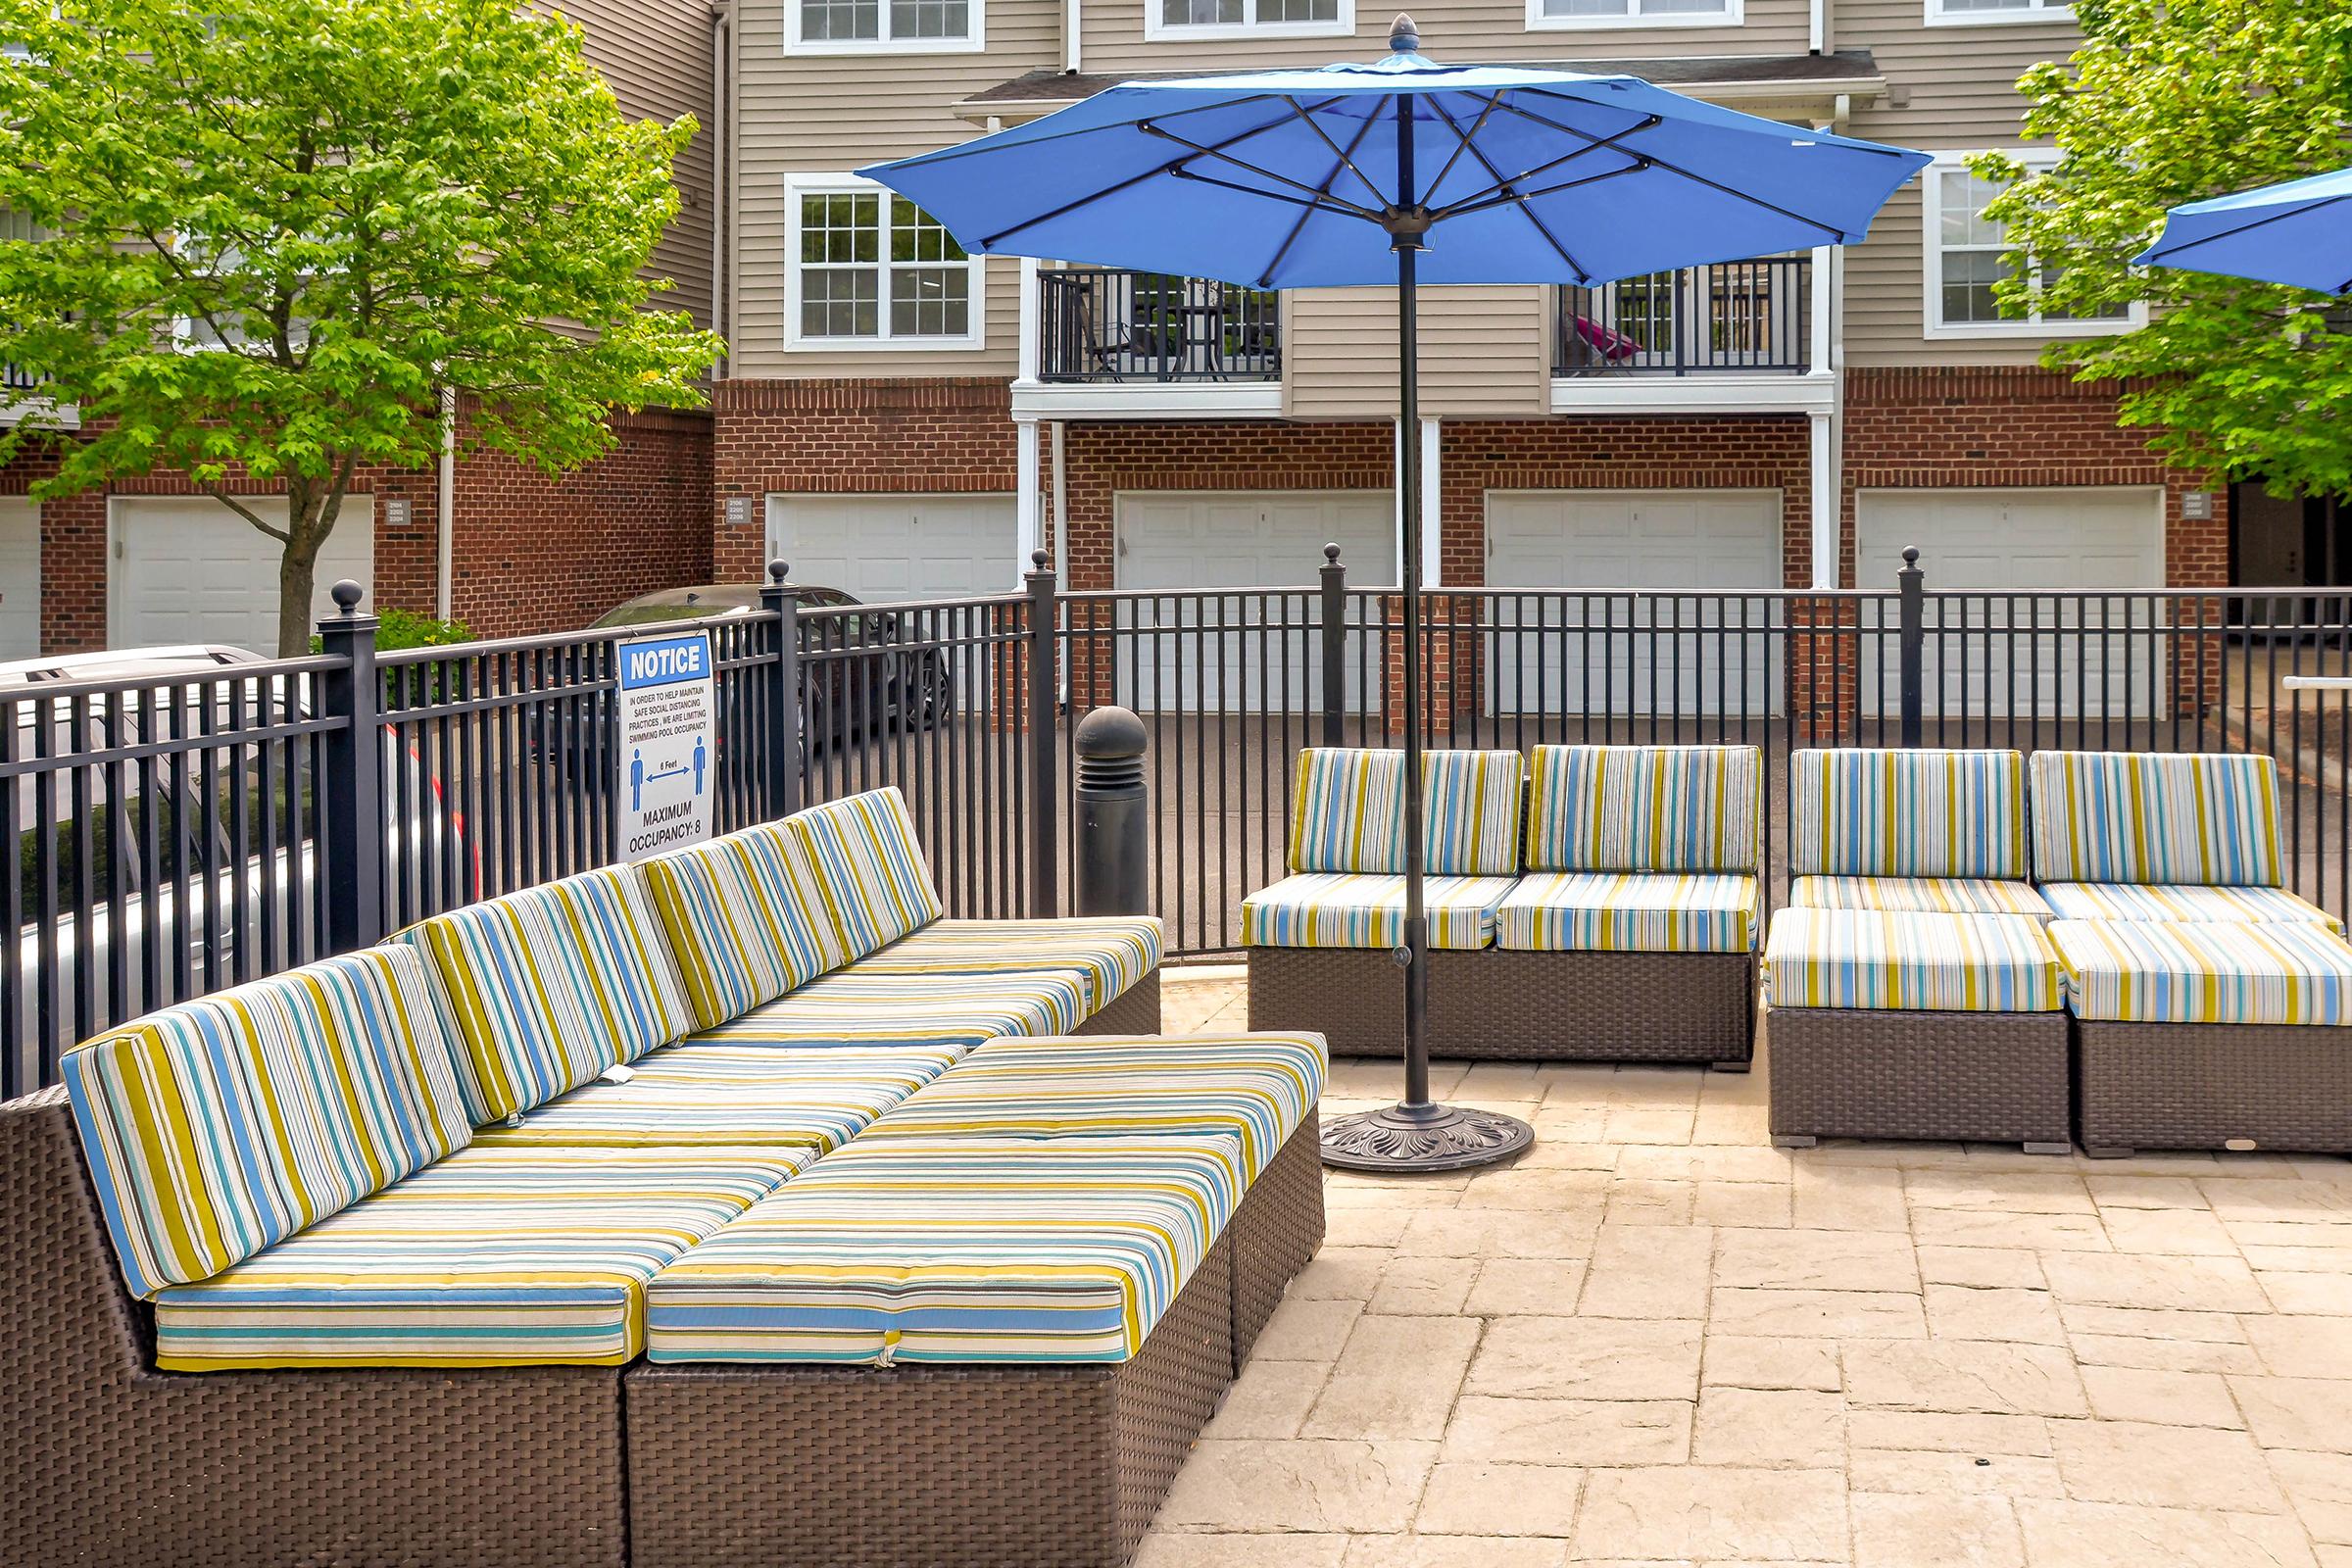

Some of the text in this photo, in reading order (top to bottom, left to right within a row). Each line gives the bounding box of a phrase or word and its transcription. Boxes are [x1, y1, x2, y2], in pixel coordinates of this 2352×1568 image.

[631, 645, 699, 680] NOTICE
[630, 686, 704, 706] IN ORDER TO HELP MAINTAIN
[634, 698, 701, 717] SAFE SOCIAL DISTANCING
[662, 716, 671, 724] WE
[671, 713, 683, 723] ARE
[683, 709, 707, 720] LIMITING
[629, 720, 707, 743] SWIMMING POOL OCCUPANCY
[660, 760, 677, 771] 6 Feet
[643, 800, 692, 827] MAXIMUM
[629, 819, 701, 854] OCCUPANCY: 8
